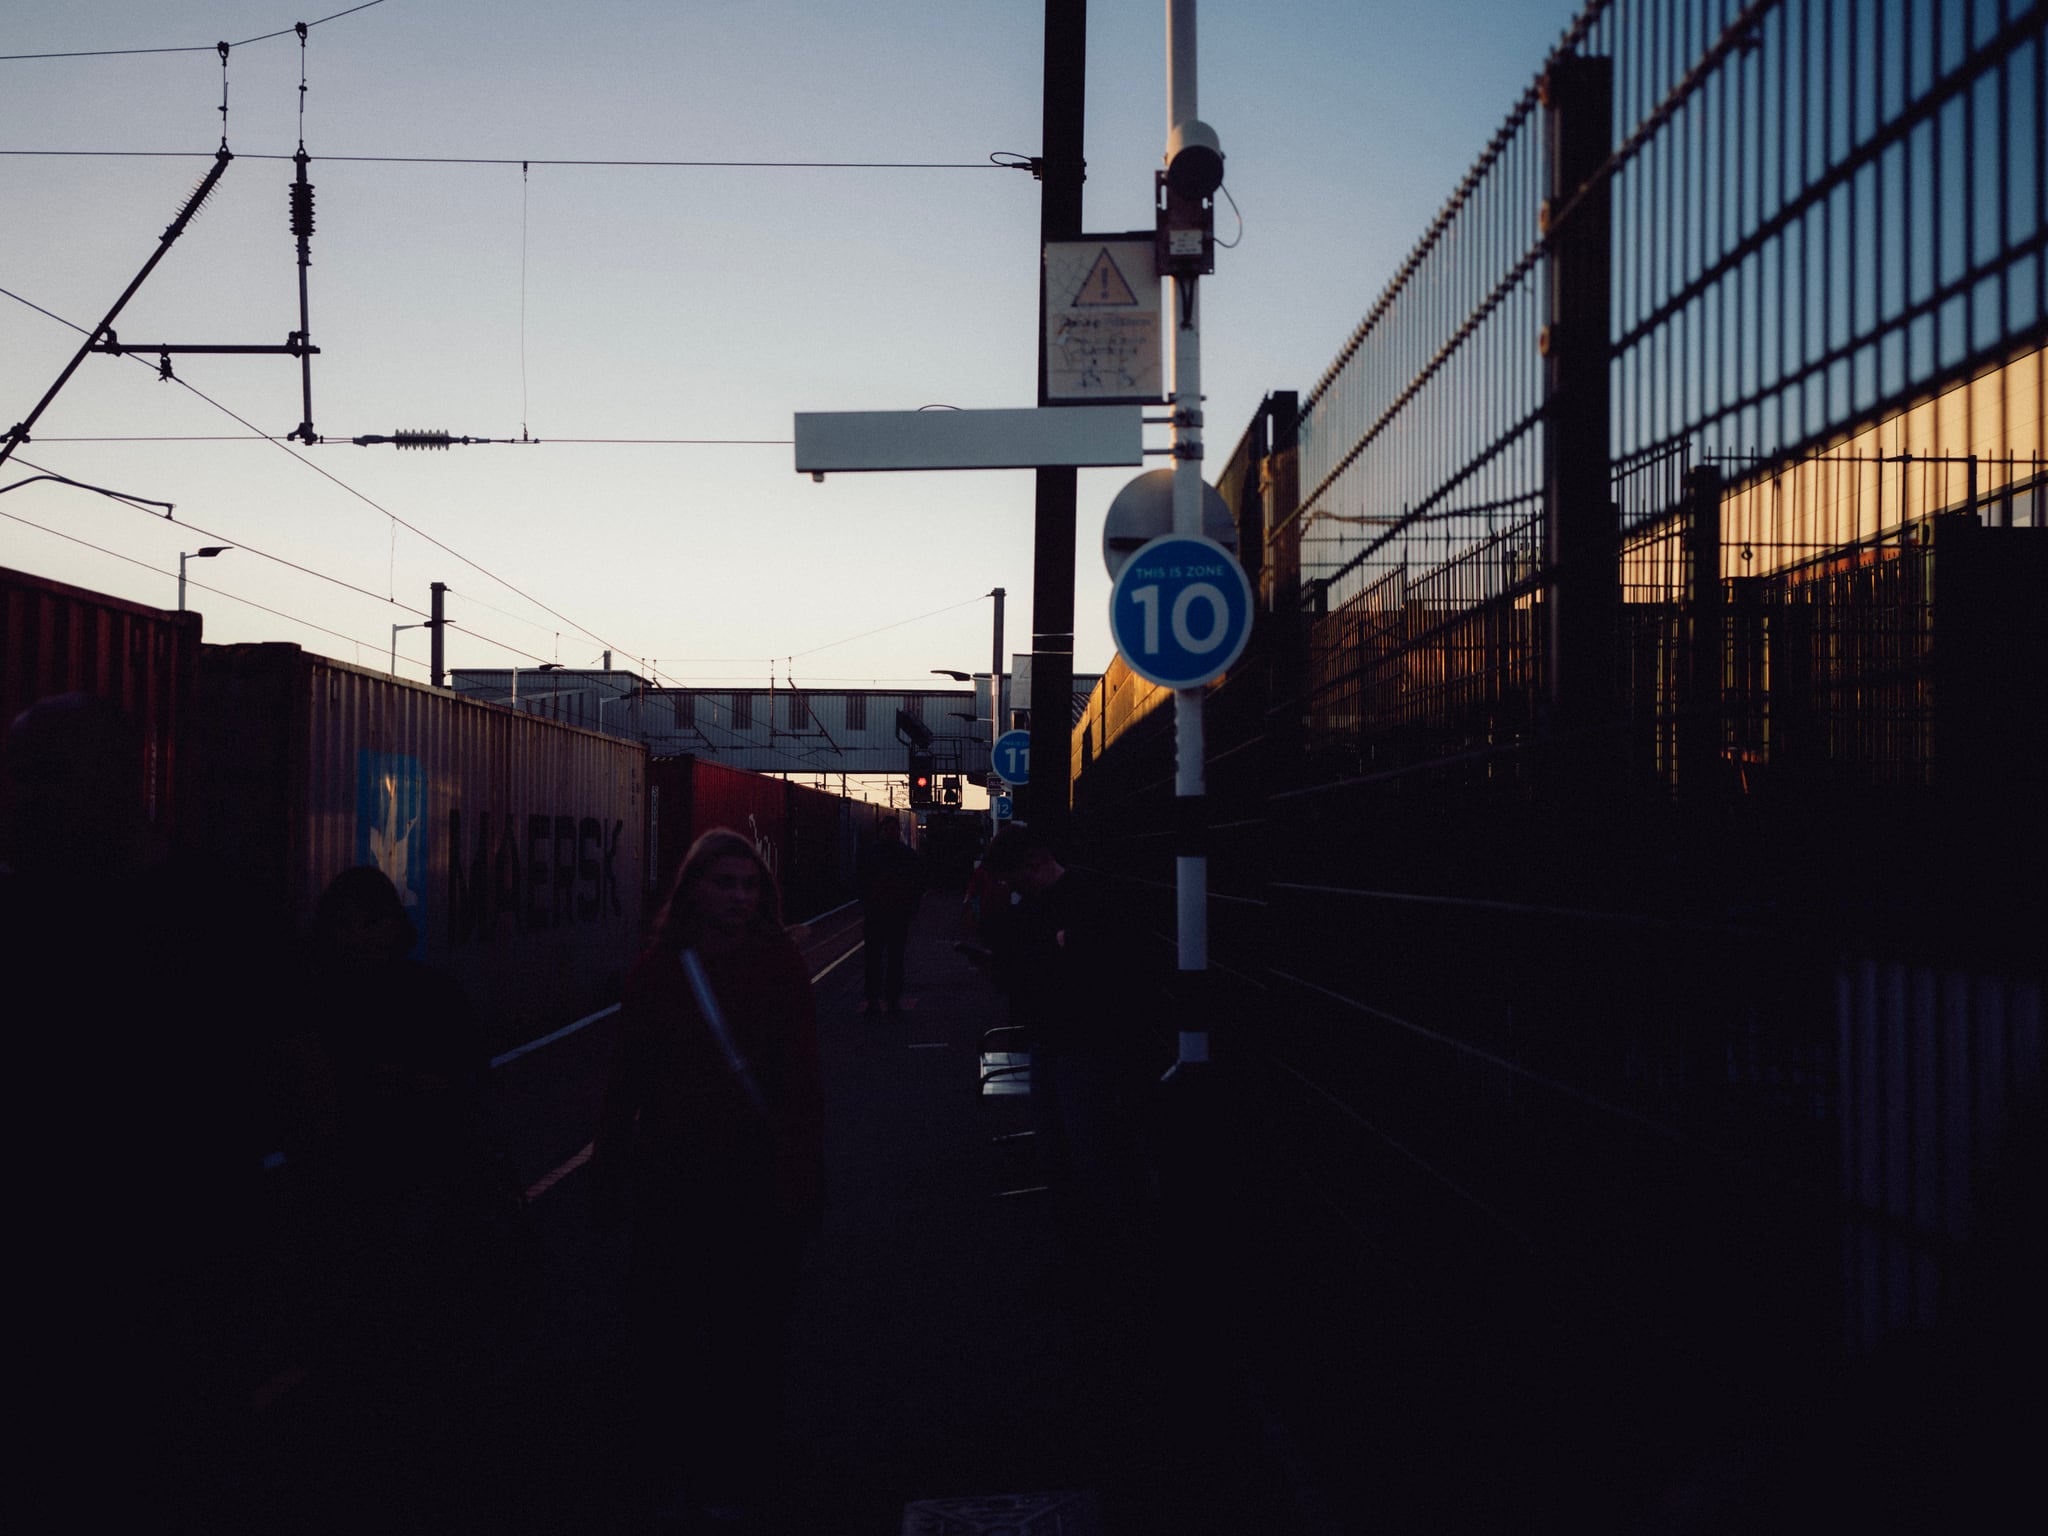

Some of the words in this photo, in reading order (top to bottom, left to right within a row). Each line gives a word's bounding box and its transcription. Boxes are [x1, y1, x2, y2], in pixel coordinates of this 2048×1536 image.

[1135, 567, 1166, 579] THIS
[1169, 566, 1182, 577] IS
[1186, 564, 1224, 577] ZONE
[1131, 582, 1230, 655] 10
[1004, 747, 1030, 774] 11
[448, 809, 623, 942] MAERSK
